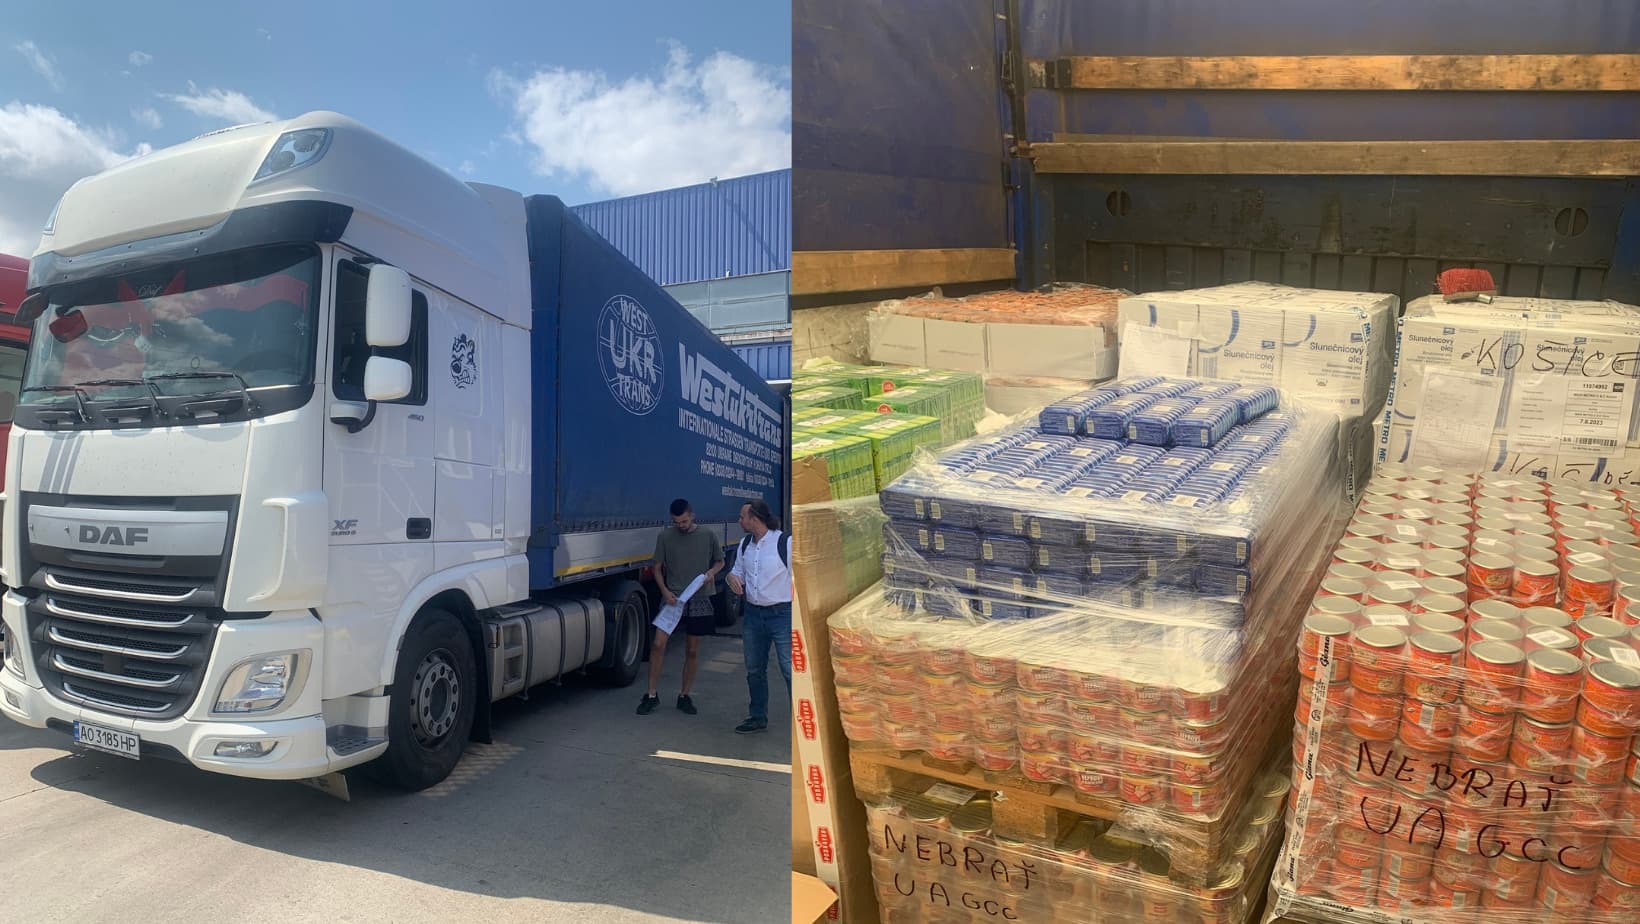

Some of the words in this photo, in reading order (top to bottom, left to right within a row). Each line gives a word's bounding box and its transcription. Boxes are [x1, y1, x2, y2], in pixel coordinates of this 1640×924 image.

[620, 297, 648, 334] WEST
[610, 319, 657, 384] UKR
[1223, 349, 1274, 361] Slunečnicový
[1310, 342, 1364, 356] Slunečnicový
[1347, 355, 1364, 365] olej
[1260, 362, 1274, 371] olej
[617, 372, 651, 406] TRANS
[1381, 410, 1392, 444] METRO
[79, 524, 149, 546] DAF
[332, 519, 359, 530] XF
[81, 726, 95, 741] AO
[95, 729, 119, 748] 3185
[120, 735, 136, 751] HP
